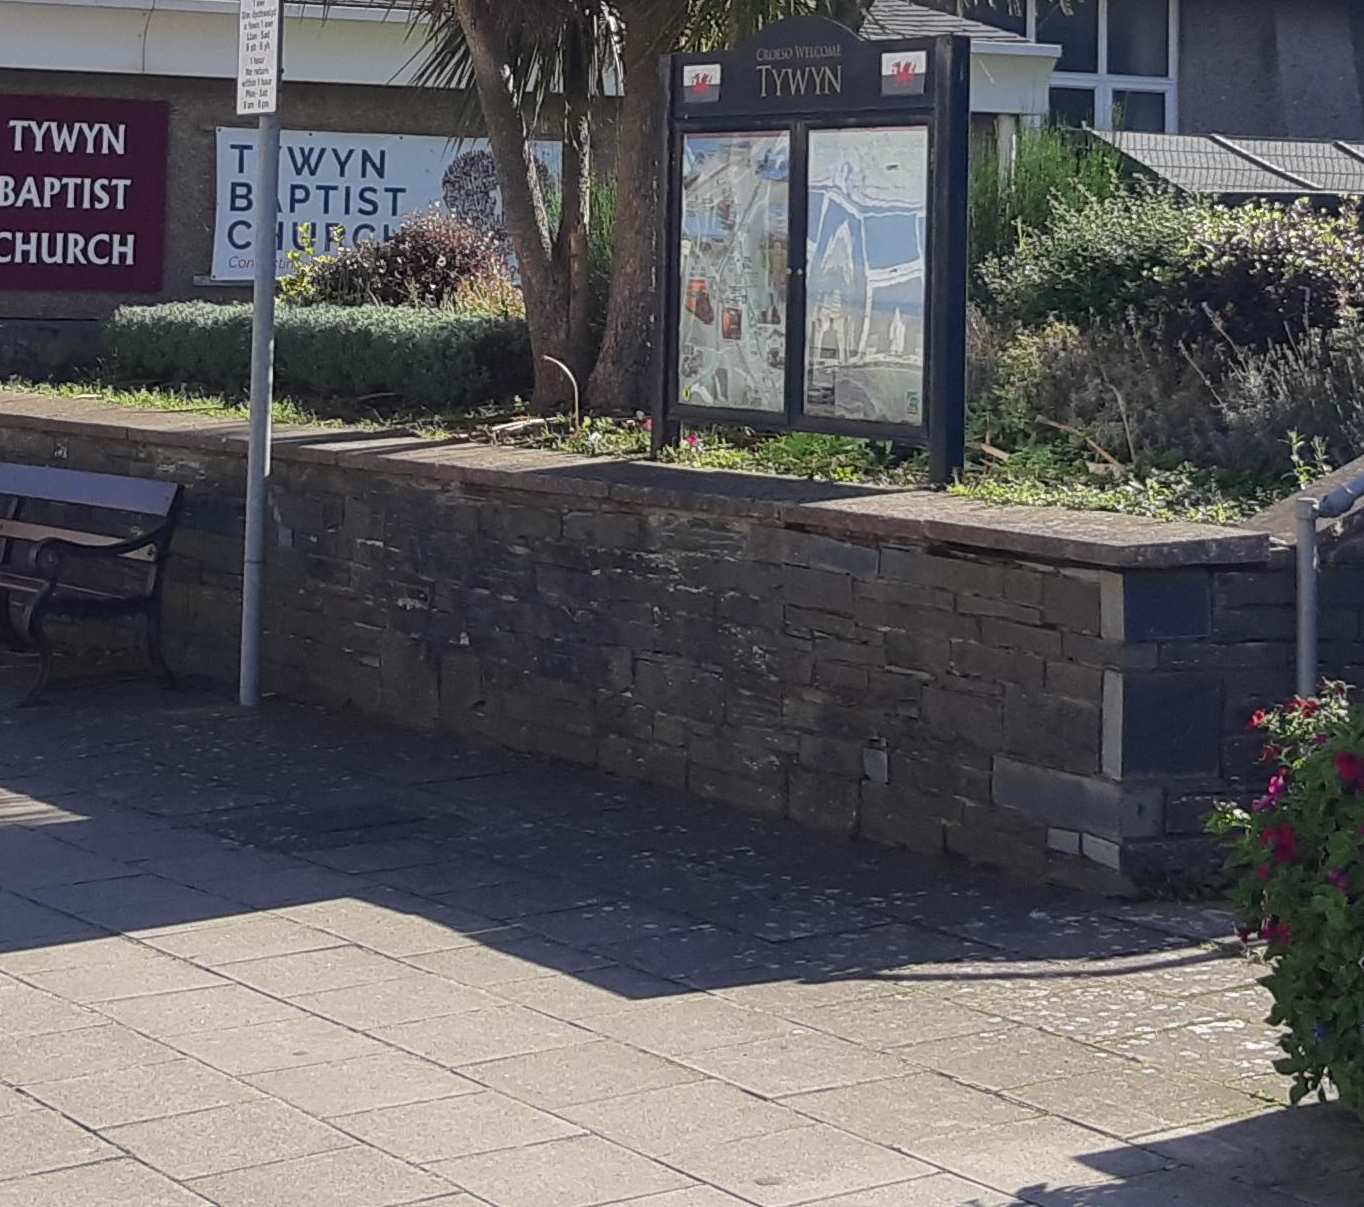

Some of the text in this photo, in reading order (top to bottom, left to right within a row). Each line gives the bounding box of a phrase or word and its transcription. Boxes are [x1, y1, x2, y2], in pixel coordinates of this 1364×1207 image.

[756, 65, 842, 97] TYWYN
[8, 119, 126, 155] TYWYN
[229, 144, 386, 179] TWYN
[229, 181, 407, 217] BPTIST
